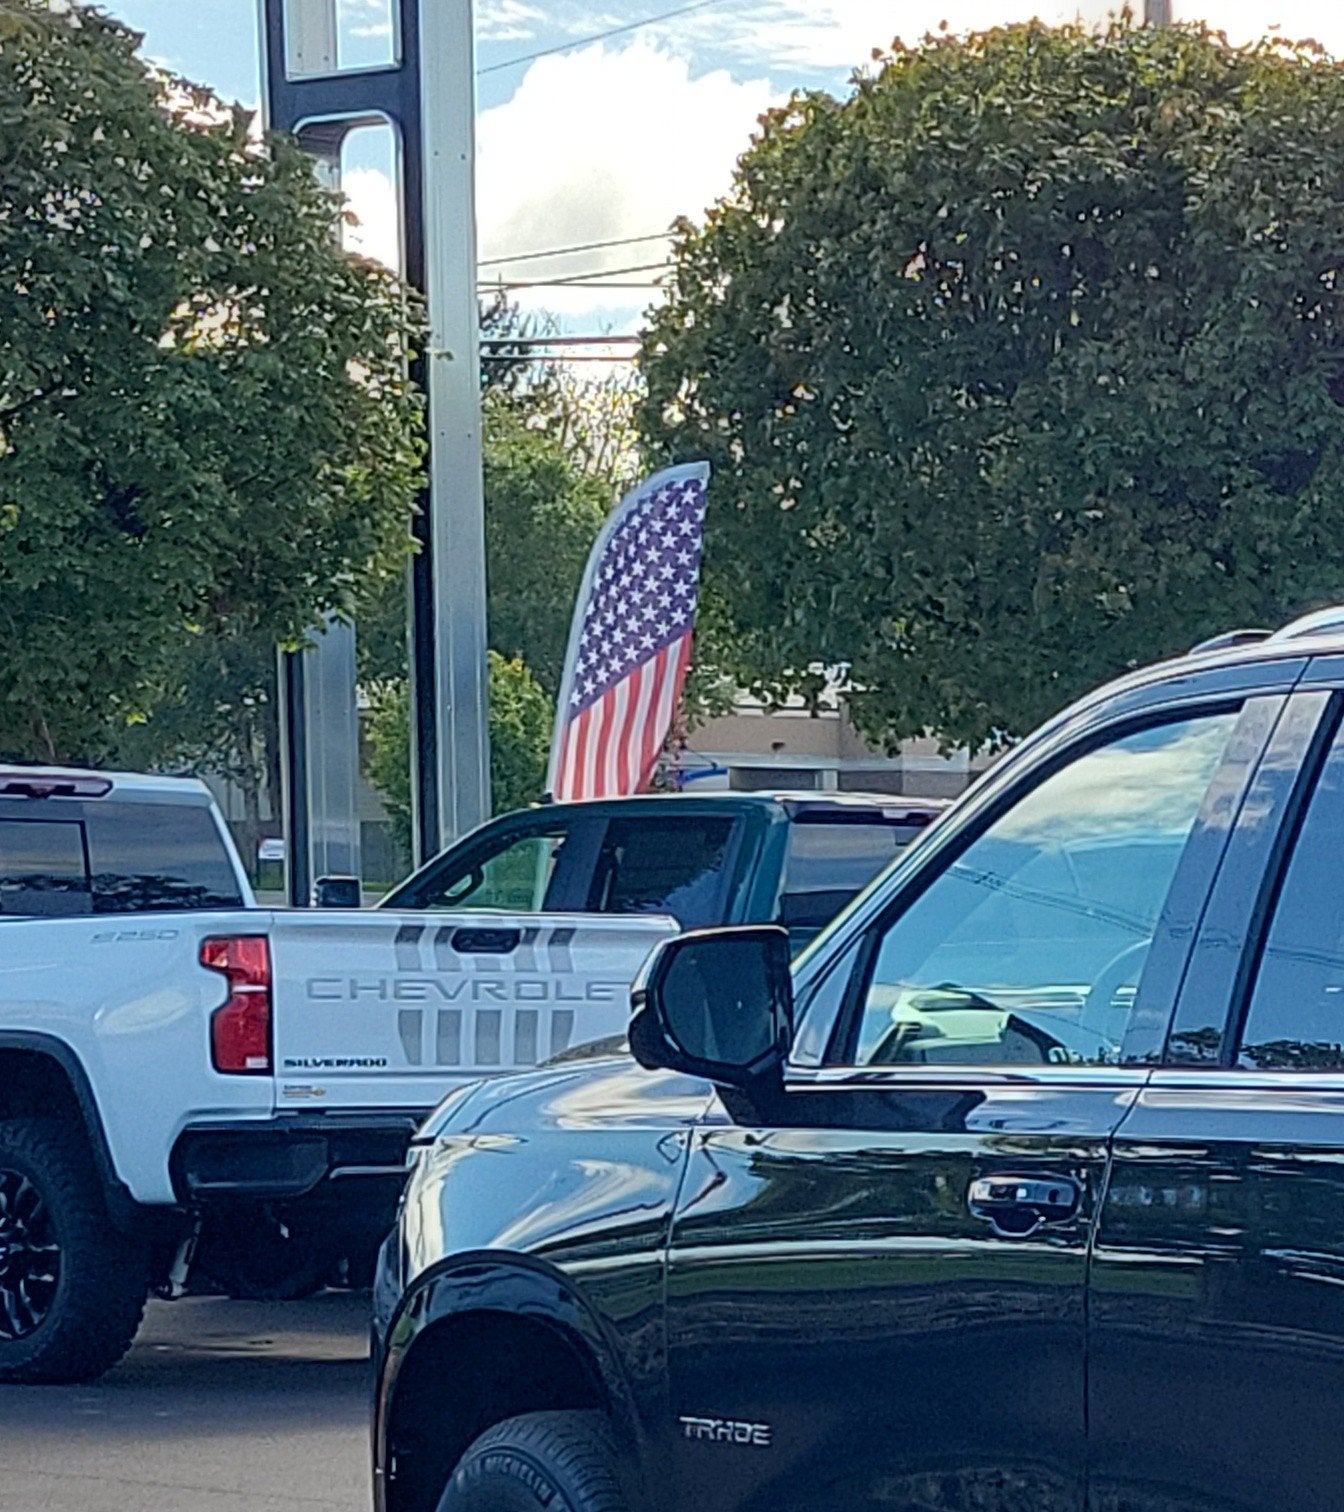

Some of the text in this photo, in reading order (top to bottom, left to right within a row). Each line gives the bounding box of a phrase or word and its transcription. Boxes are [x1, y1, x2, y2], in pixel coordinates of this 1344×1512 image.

[305, 977, 631, 1001] CHEVROLE
[283, 1057, 387, 1069] SILVERADO
[679, 1415, 773, 1445] TAHOE
[484, 1455, 553, 1502] MICHELIN
